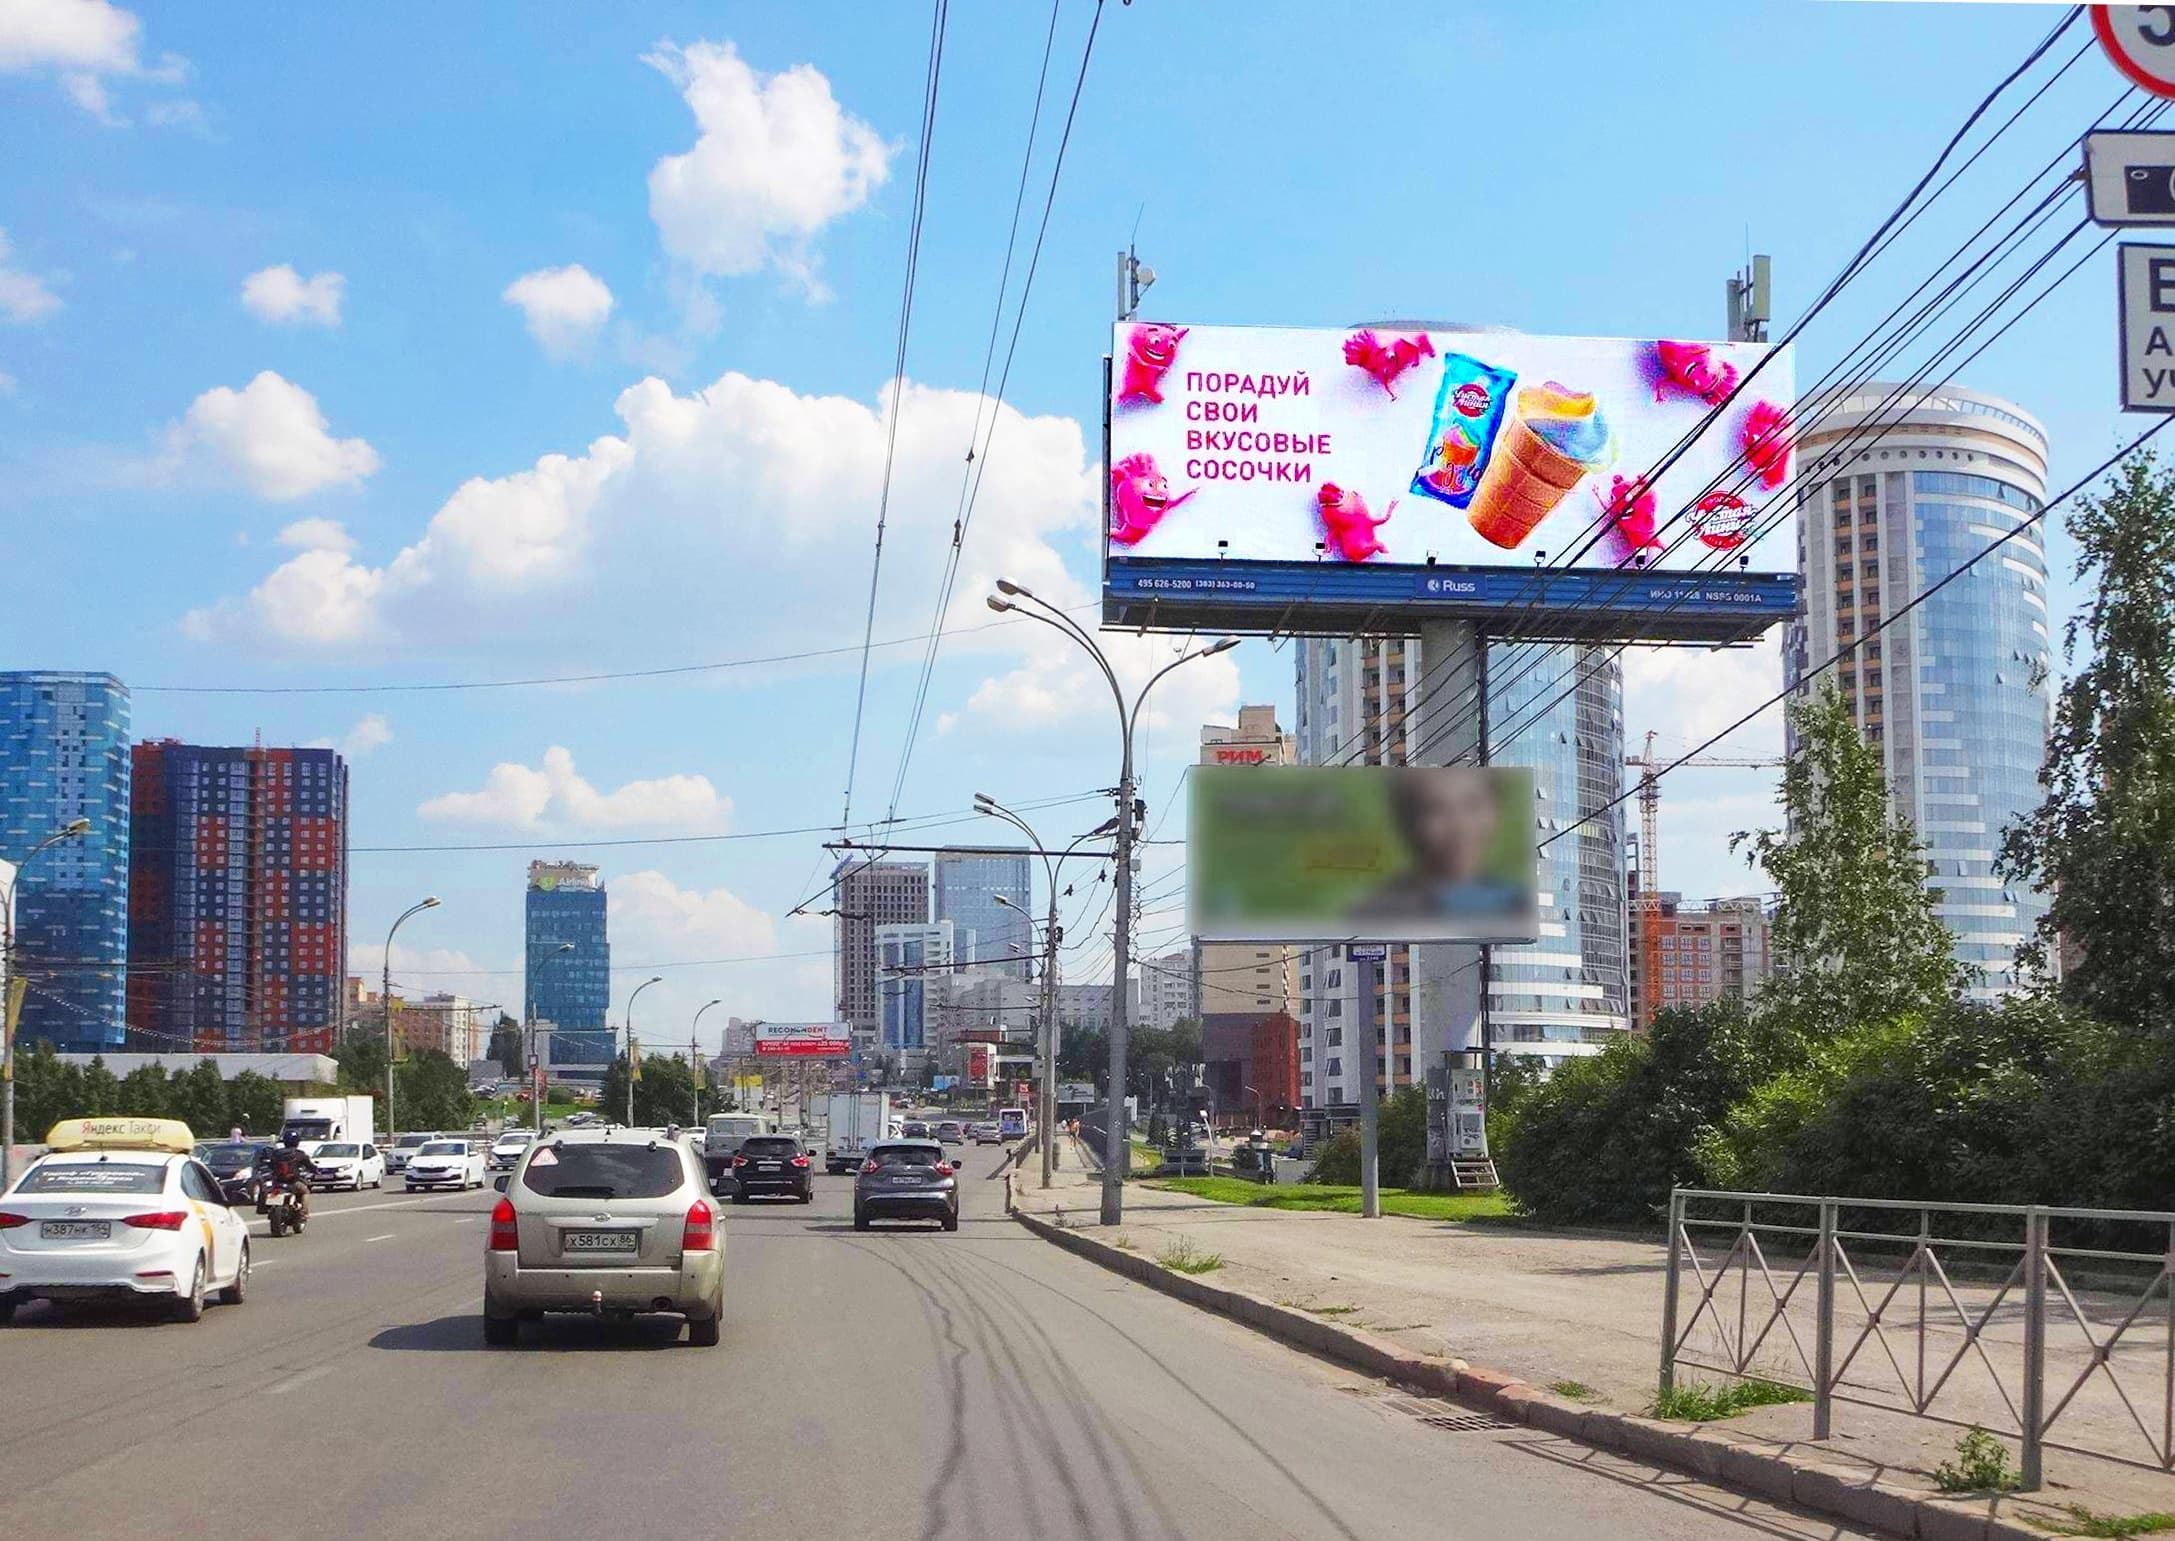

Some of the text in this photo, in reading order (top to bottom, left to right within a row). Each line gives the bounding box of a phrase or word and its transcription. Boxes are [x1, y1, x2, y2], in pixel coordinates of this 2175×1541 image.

[1187, 371, 1309, 399] ПОРАДУЙ
[1187, 401, 1258, 423] СВОИ
[1187, 430, 1332, 454] ВКУСОВЫЕ
[1187, 459, 1311, 483] СОСОЧКИ
[1138, 579, 1192, 588] 495 626-5200
[1442, 579, 1476, 592] Russ
[1216, 750, 1264, 762] РИМ
[82, 1121, 161, 1135] Яндекс Такси
